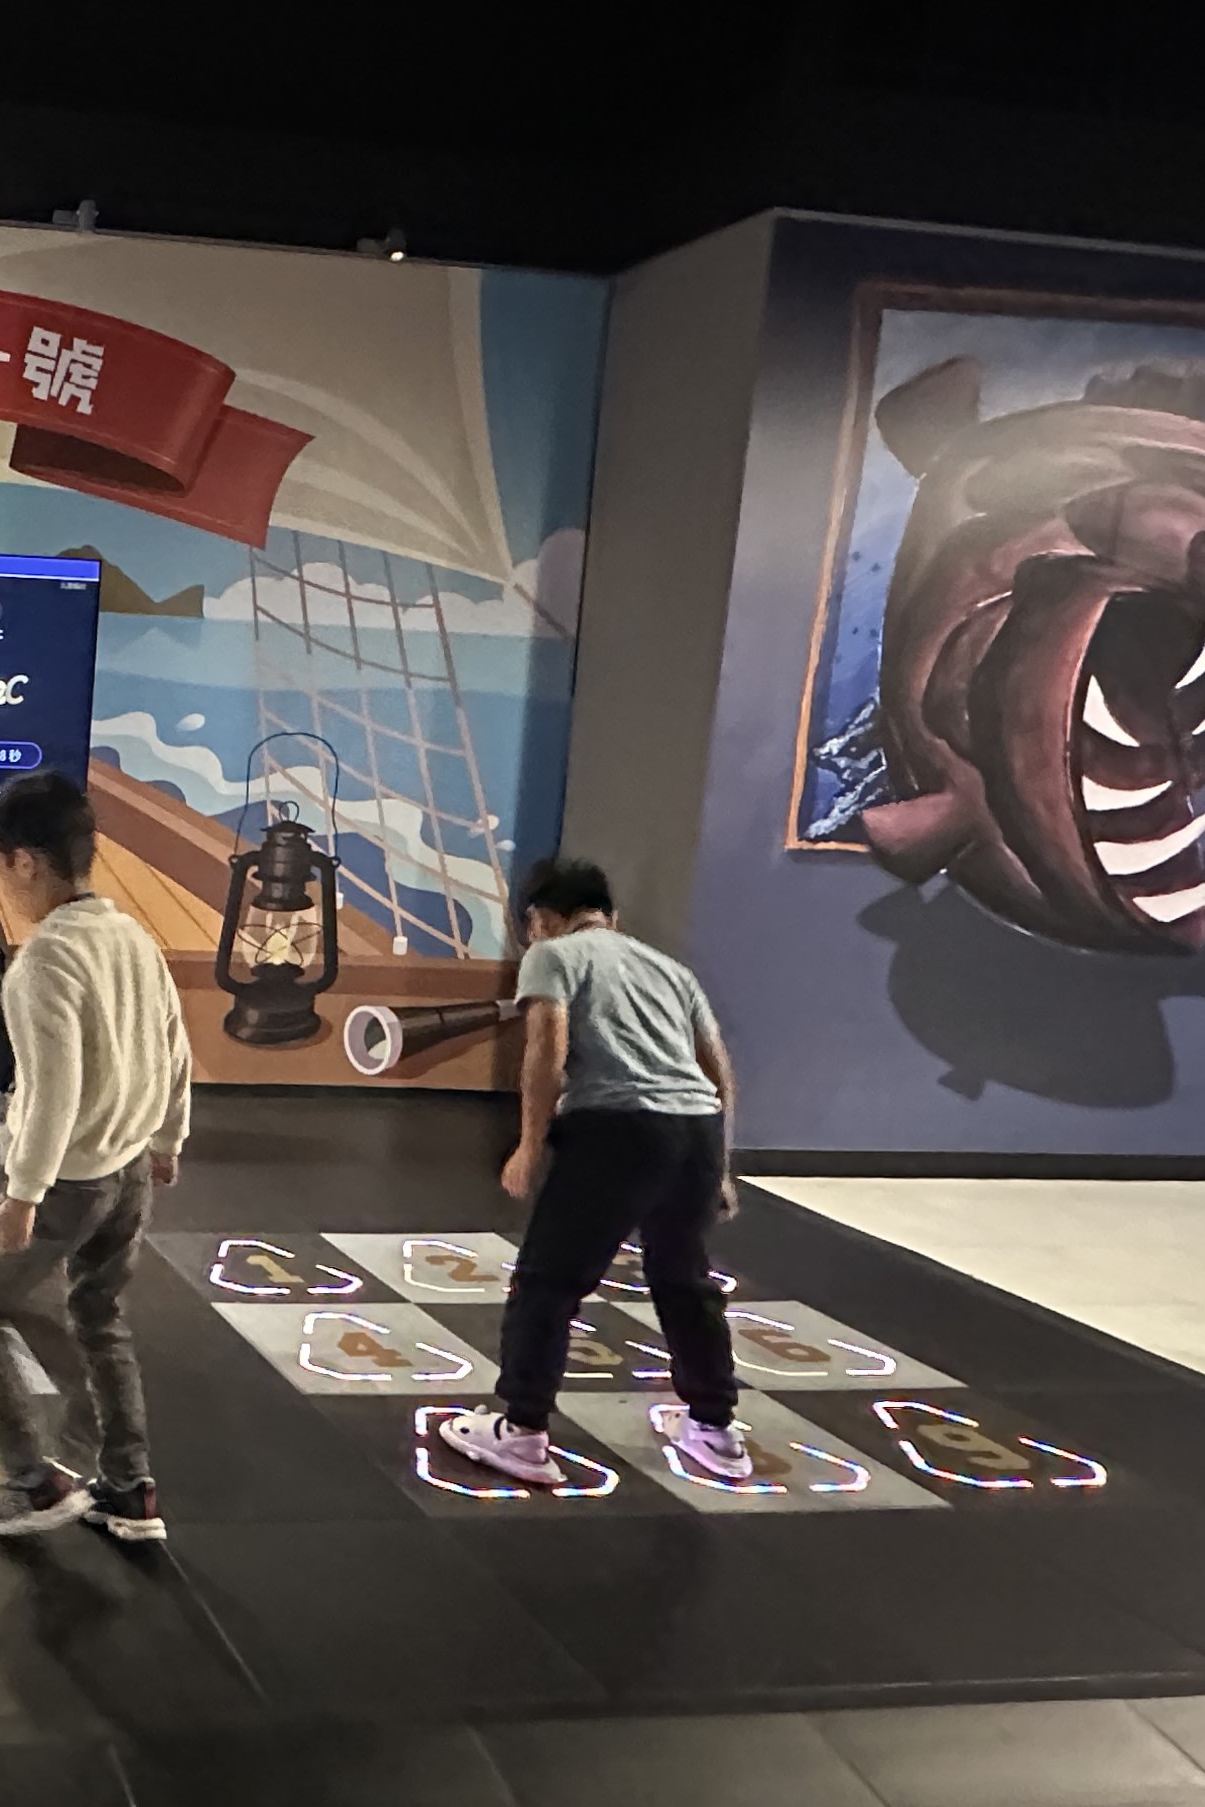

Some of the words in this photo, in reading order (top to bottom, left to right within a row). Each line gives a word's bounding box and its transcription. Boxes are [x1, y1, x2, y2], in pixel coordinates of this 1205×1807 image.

[246, 1254, 305, 1283] 1
[425, 1254, 500, 1282] 2
[337, 1332, 414, 1368] 4
[738, 1328, 831, 1363] 6
[917, 1424, 1031, 1470] 9
